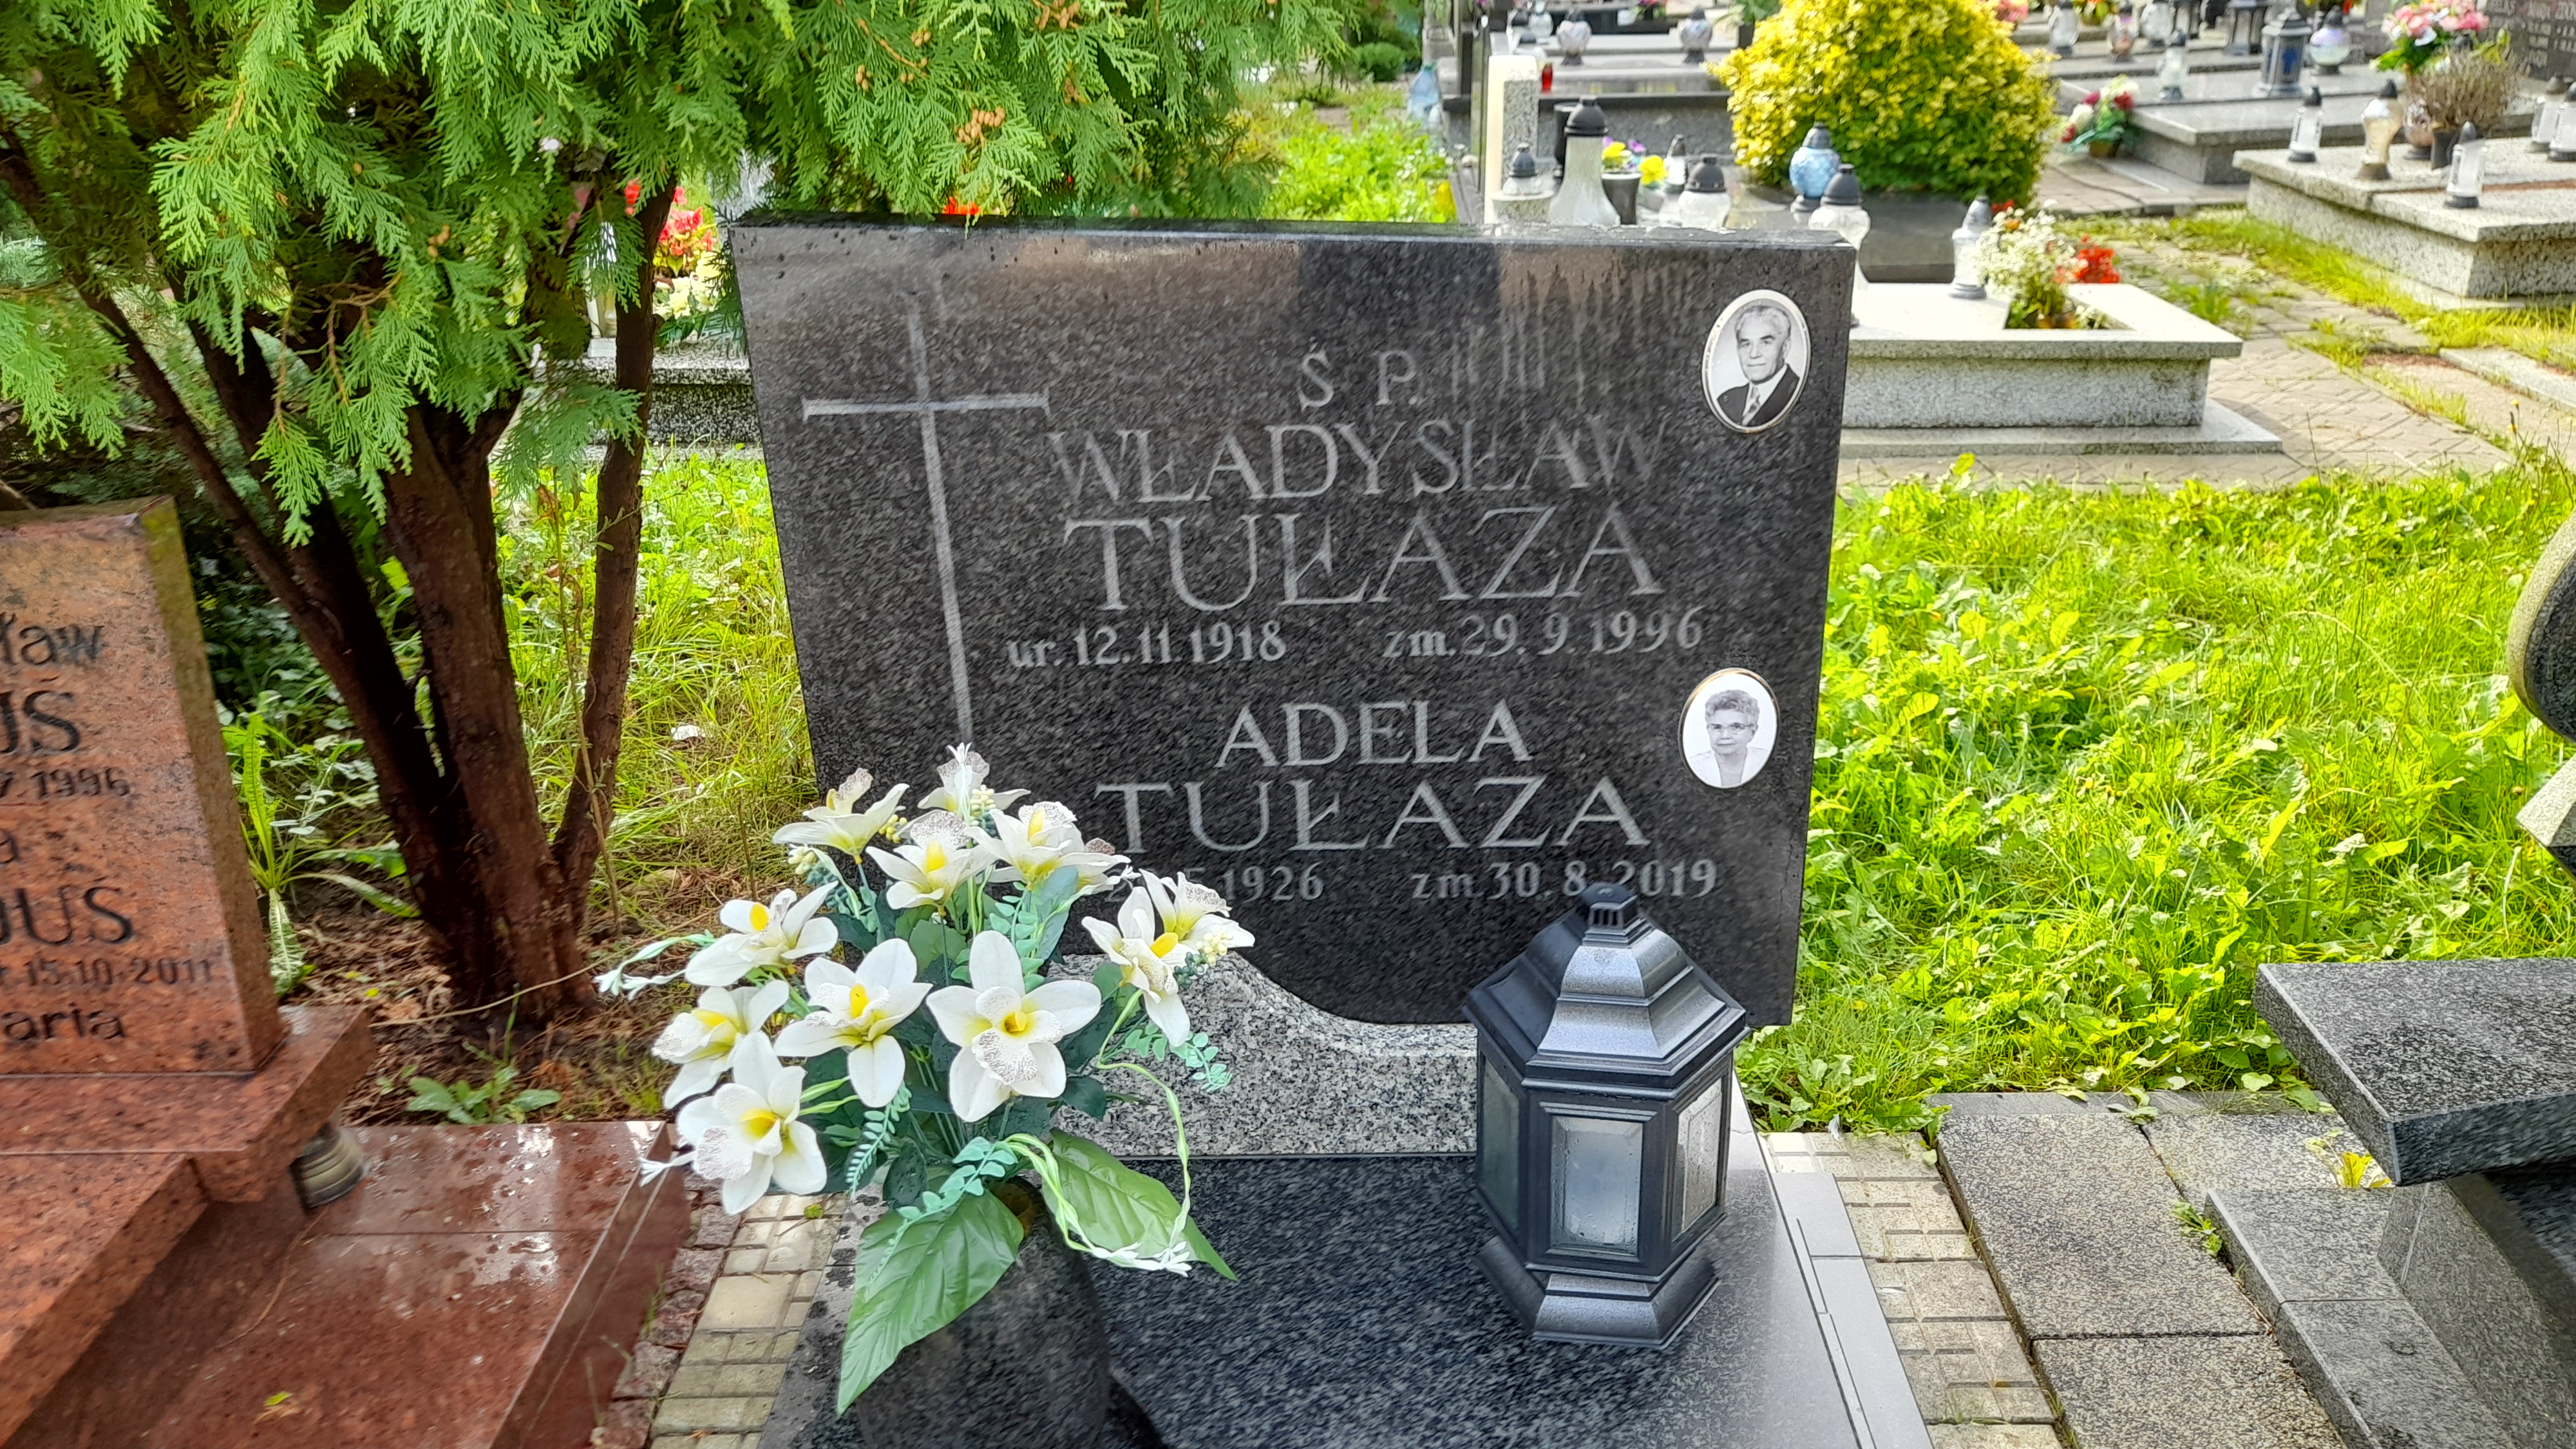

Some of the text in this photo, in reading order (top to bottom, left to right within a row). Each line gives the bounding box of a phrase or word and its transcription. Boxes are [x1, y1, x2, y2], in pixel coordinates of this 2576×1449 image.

[1047, 415, 1667, 503] WŁADYSŁAW
[1061, 501, 1666, 612] TUŁAZA
[1214, 698, 1534, 769] ADELA
[1093, 775, 1651, 854] TUŁAZA
